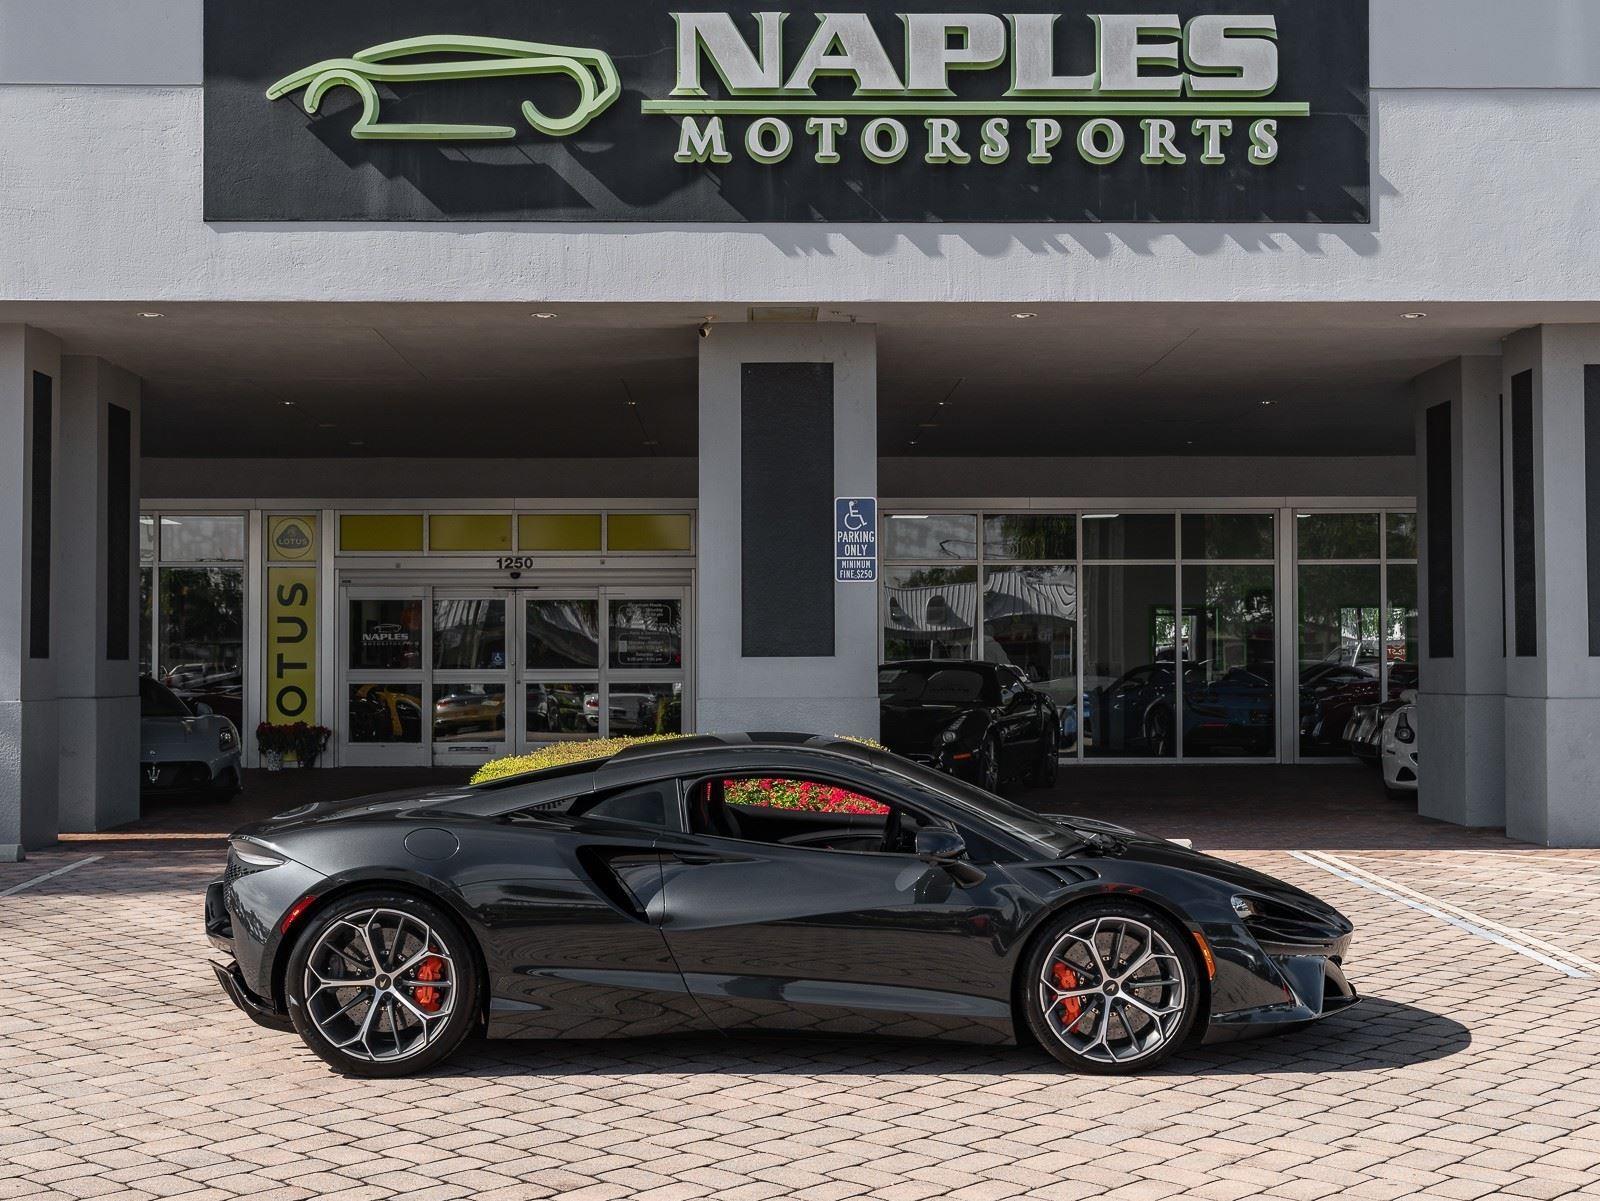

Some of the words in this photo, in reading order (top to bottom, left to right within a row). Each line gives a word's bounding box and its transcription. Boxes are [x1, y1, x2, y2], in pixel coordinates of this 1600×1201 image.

[668, 12, 1278, 97] NAPLES
[673, 116, 1278, 165] MOTORSPORTS
[837, 531, 875, 543] PARKING
[844, 544, 868, 556] ONLY
[496, 556, 533, 569] 1250
[841, 560, 871, 569] MINIMUM
[362, 633, 409, 641] NAPLES
[276, 582, 308, 717] OTUS
